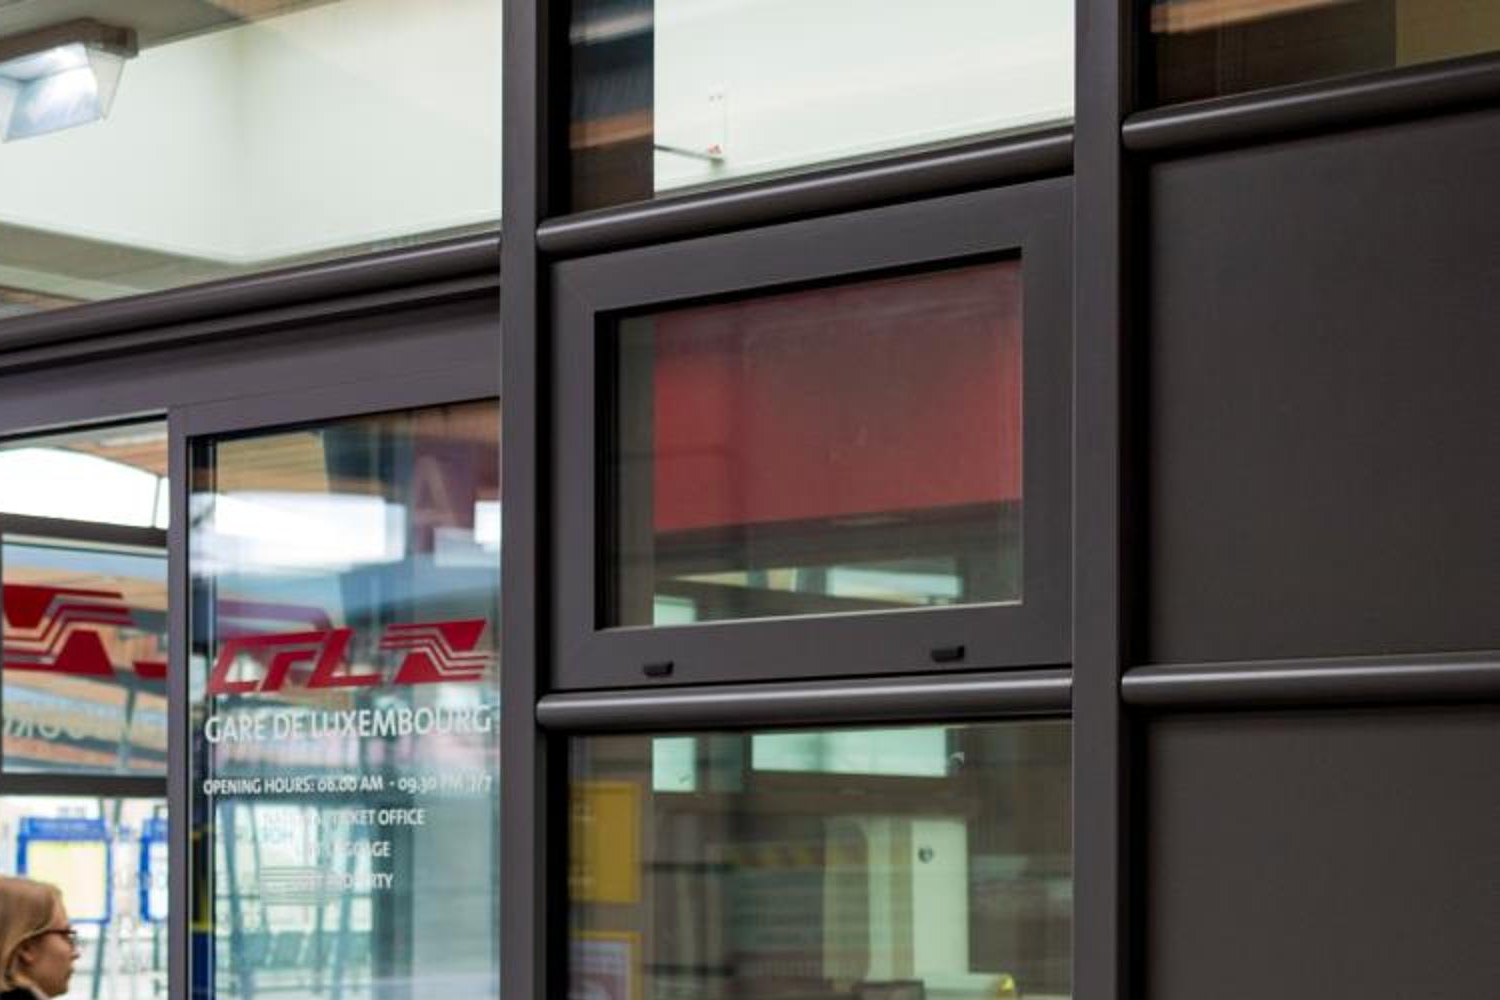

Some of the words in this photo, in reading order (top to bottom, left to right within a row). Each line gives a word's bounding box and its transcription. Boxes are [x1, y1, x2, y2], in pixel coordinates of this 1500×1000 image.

[205, 715, 267, 743] GARE
[273, 712, 304, 739] DE
[311, 704, 491, 738] LUXEMBOURG
[203, 778, 261, 795] OPENING
[264, 776, 315, 793] HOURS:
[359, 776, 383, 791] AM
[378, 807, 427, 826] OFFICE
